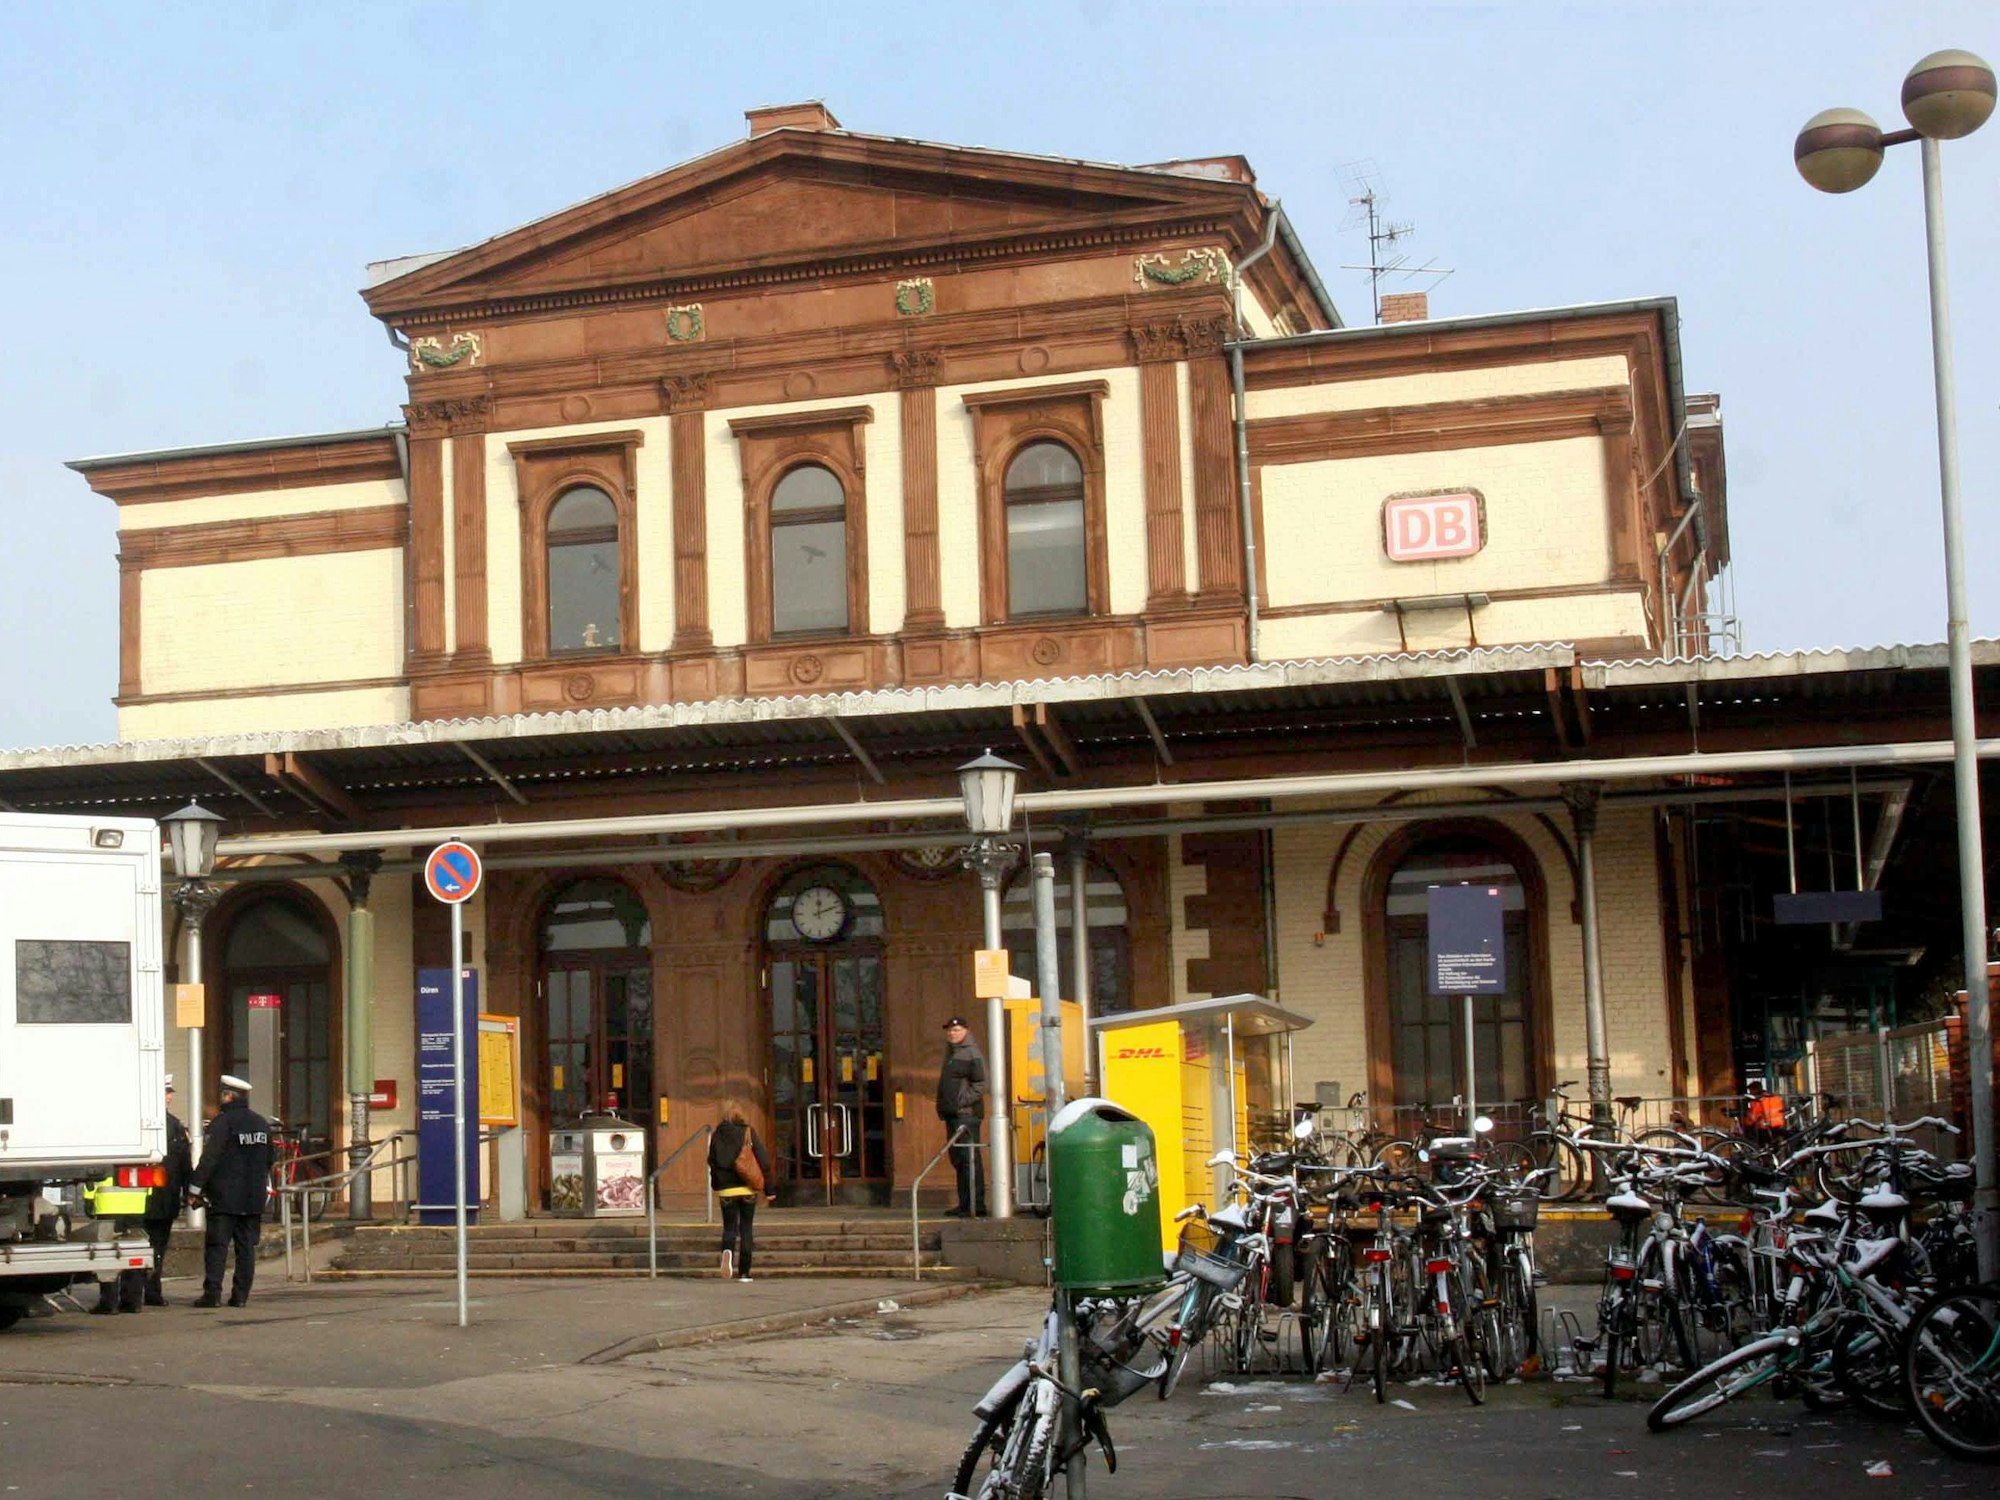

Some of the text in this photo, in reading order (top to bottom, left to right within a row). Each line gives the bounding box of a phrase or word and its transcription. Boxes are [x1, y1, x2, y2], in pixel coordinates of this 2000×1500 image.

[1399, 507, 1466, 549] DB
[1118, 1048, 1165, 1059] DHL
[239, 1131, 268, 1145] POLIZEI
